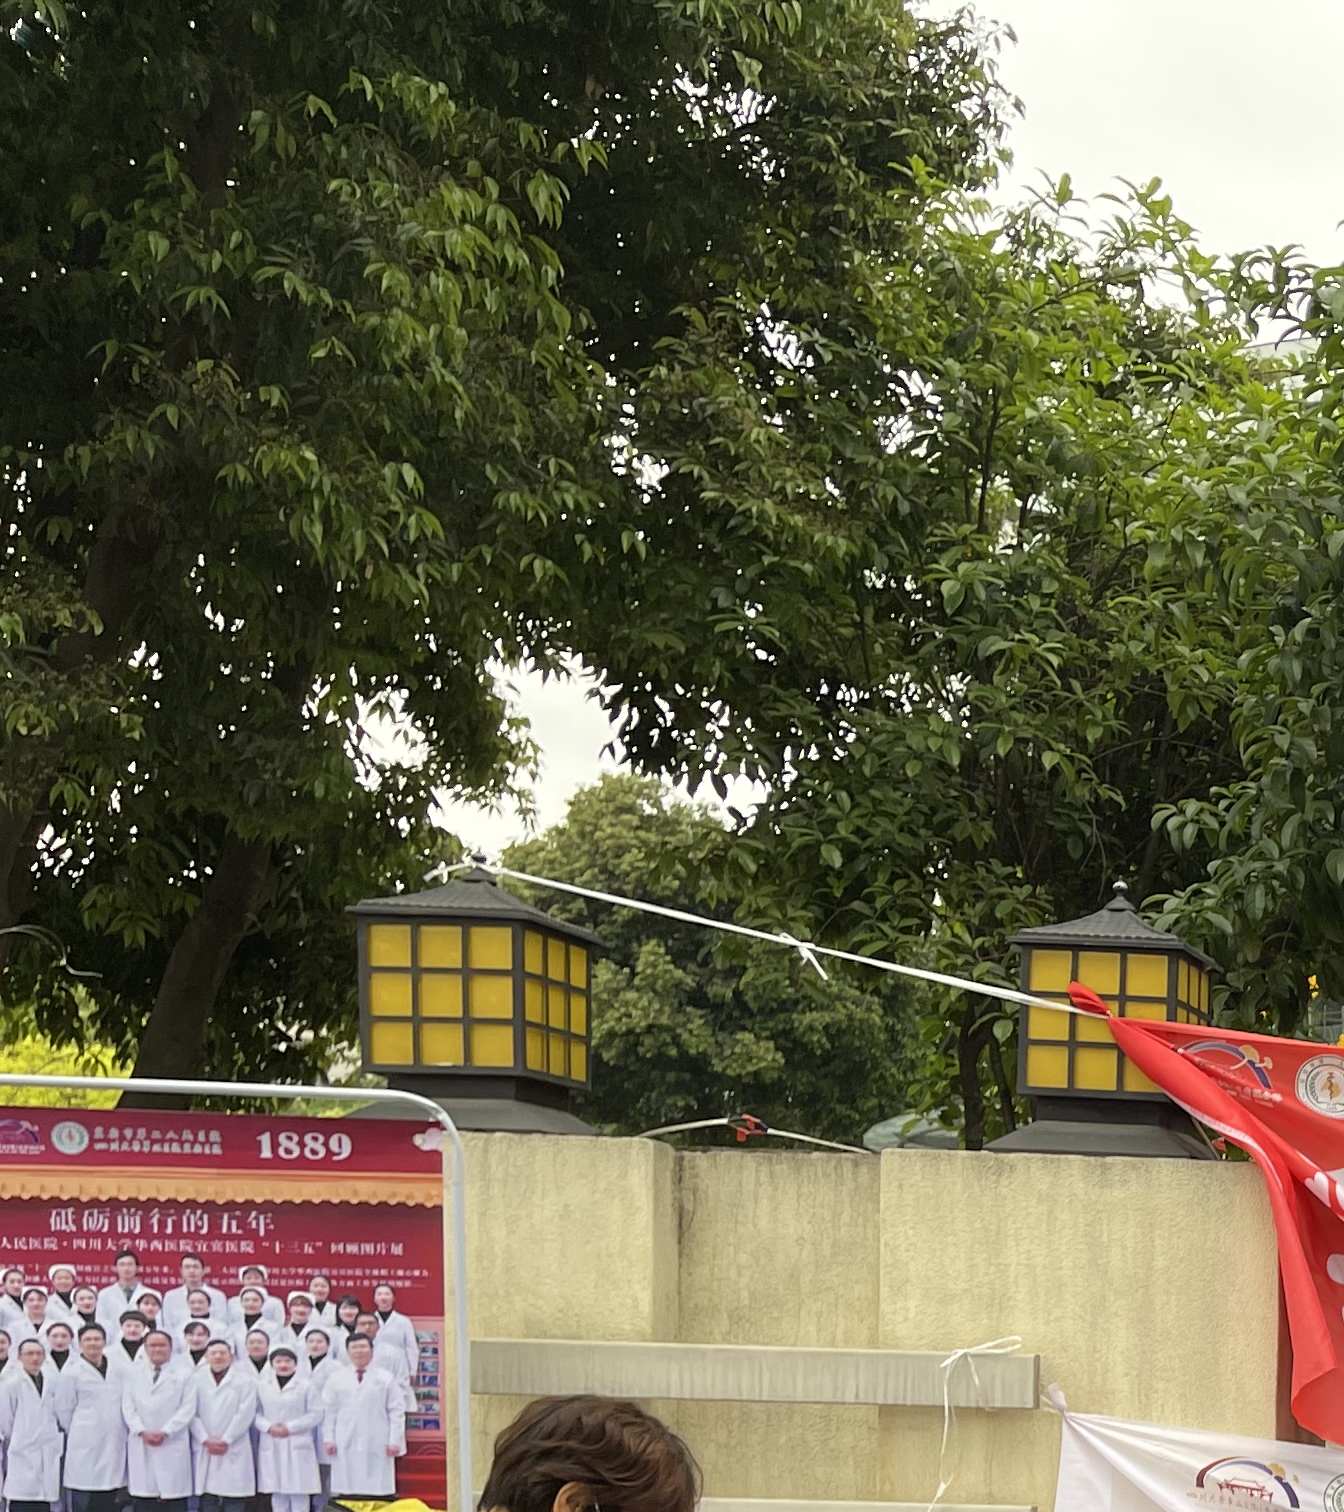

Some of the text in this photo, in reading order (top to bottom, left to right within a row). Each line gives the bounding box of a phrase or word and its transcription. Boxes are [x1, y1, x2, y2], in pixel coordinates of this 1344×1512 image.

[255, 1131, 353, 1162] 1889
[49, 1206, 275, 1237] 砥砺前行的五年
